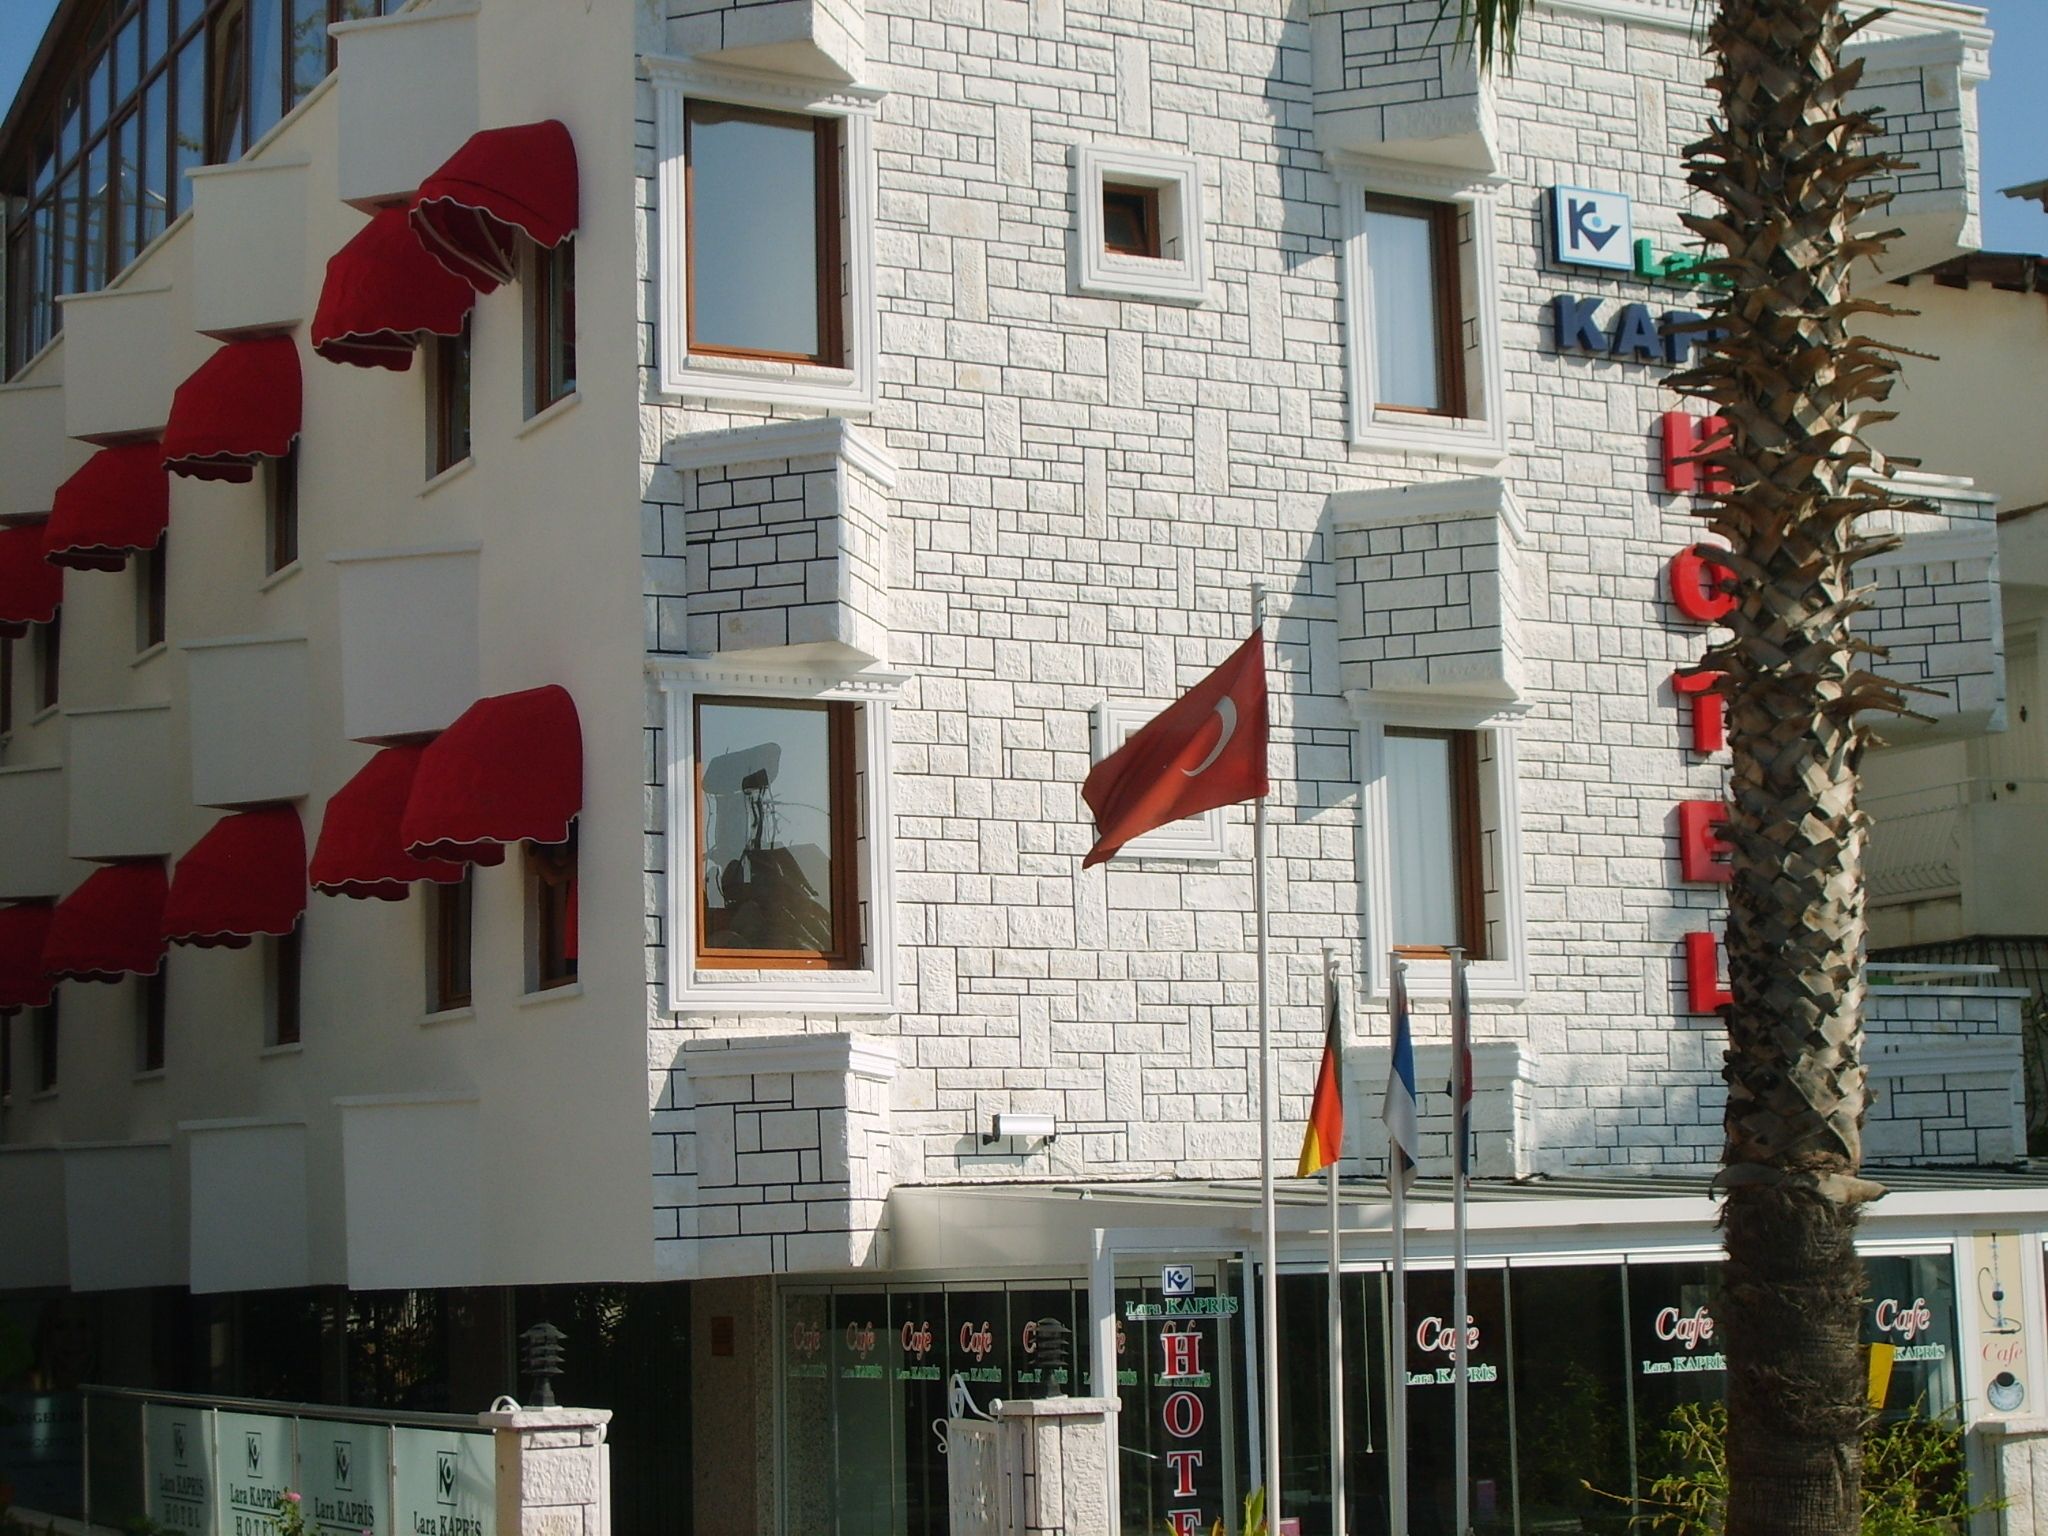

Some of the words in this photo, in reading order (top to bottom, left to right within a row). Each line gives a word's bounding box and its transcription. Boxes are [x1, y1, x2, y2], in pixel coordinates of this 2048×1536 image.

[1552, 294, 1730, 363] KAP
[1126, 1301, 1162, 1317] Lara
[1876, 1297, 1932, 1341] Cafe
[901, 1321, 933, 1361] Cafe
[960, 1321, 992, 1362] Cafe
[1655, 1306, 1715, 1351] Cafe
[1643, 1360, 1672, 1375] Lara
[1982, 1341, 2024, 1368] Cafe
[230, 1483, 248, 1505] Lara
[314, 1497, 335, 1520] Lara
[413, 1511, 437, 1536] Lara
